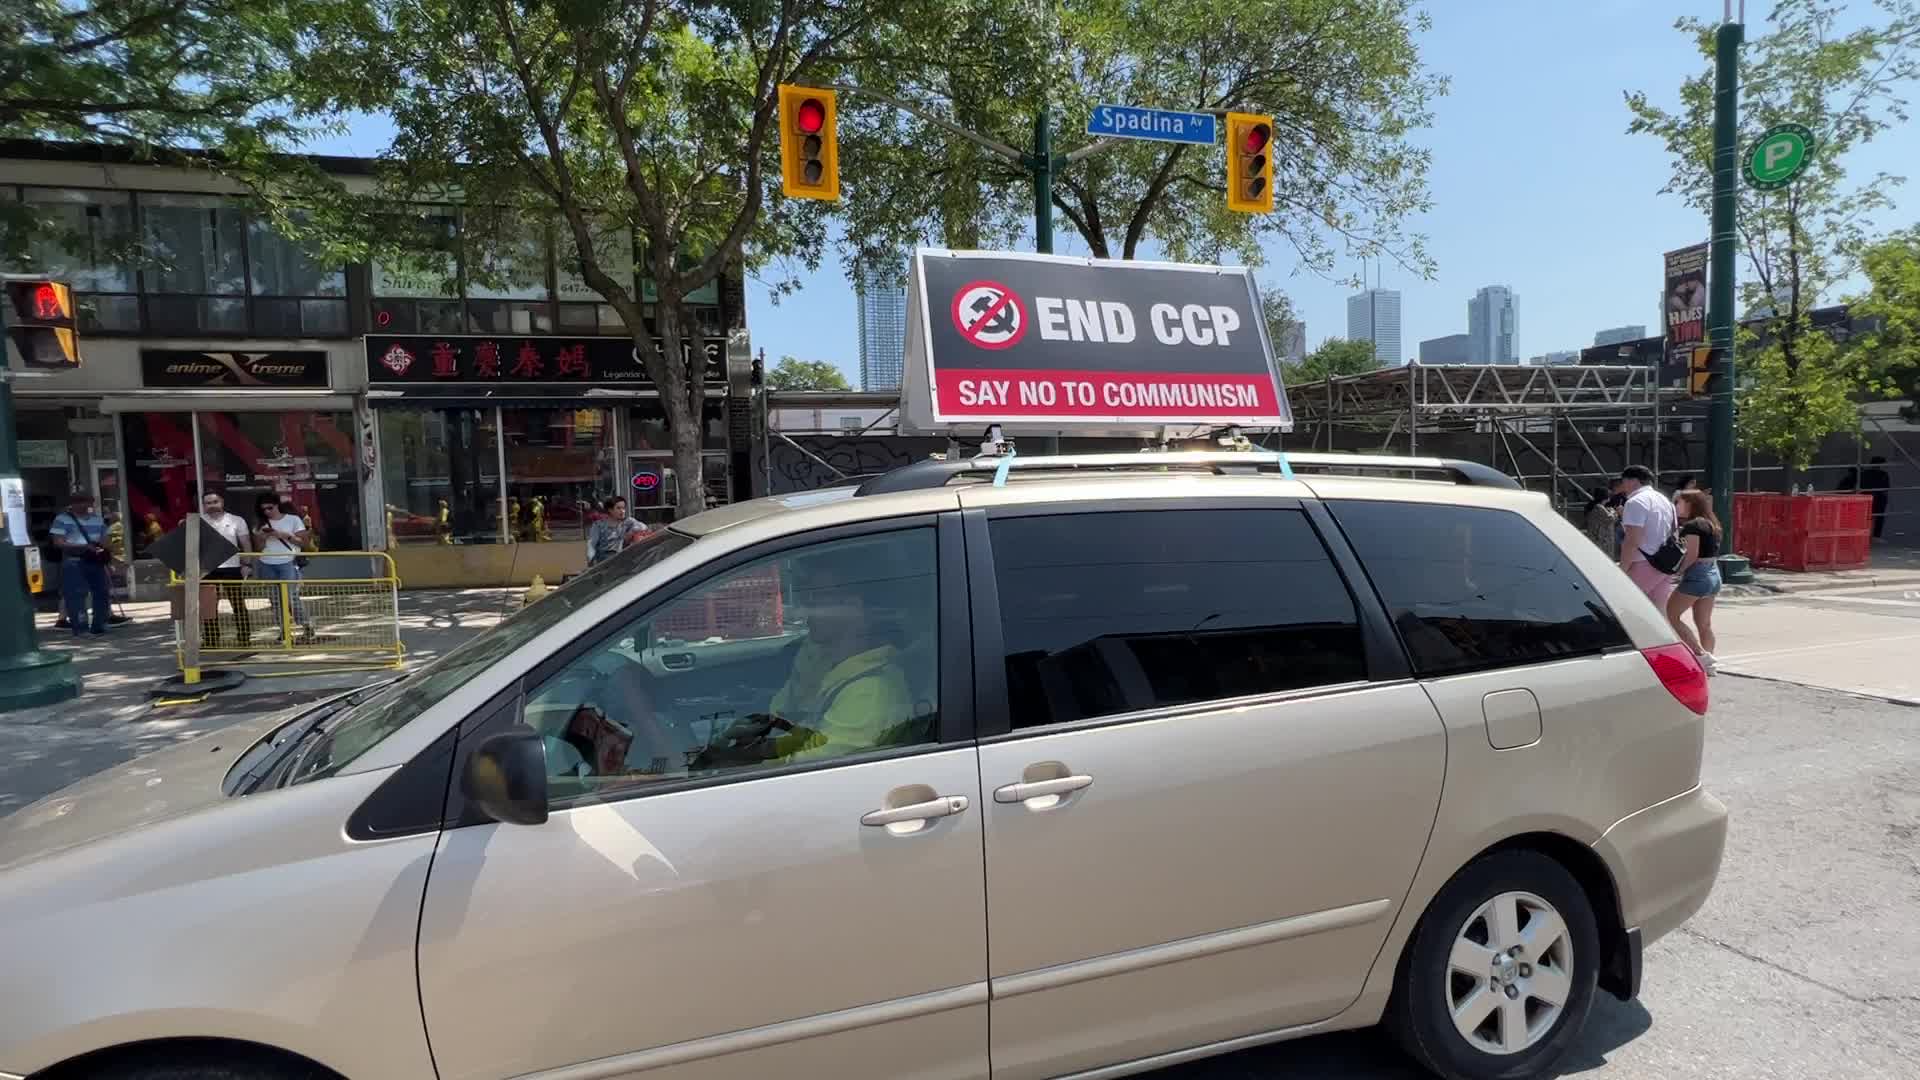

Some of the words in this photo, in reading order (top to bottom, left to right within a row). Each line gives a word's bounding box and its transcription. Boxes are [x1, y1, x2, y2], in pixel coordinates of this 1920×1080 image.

[1102, 107, 1184, 134] Spadina
[1190, 116, 1204, 127] Av
[1765, 141, 1793, 170] P
[1035, 296, 1137, 344] END
[1150, 303, 1241, 346] CCP
[958, 379, 1010, 406] SAY
[1018, 380, 1057, 406] NO
[1061, 381, 1096, 407] TO
[1103, 382, 1260, 408] COMMUNISM
